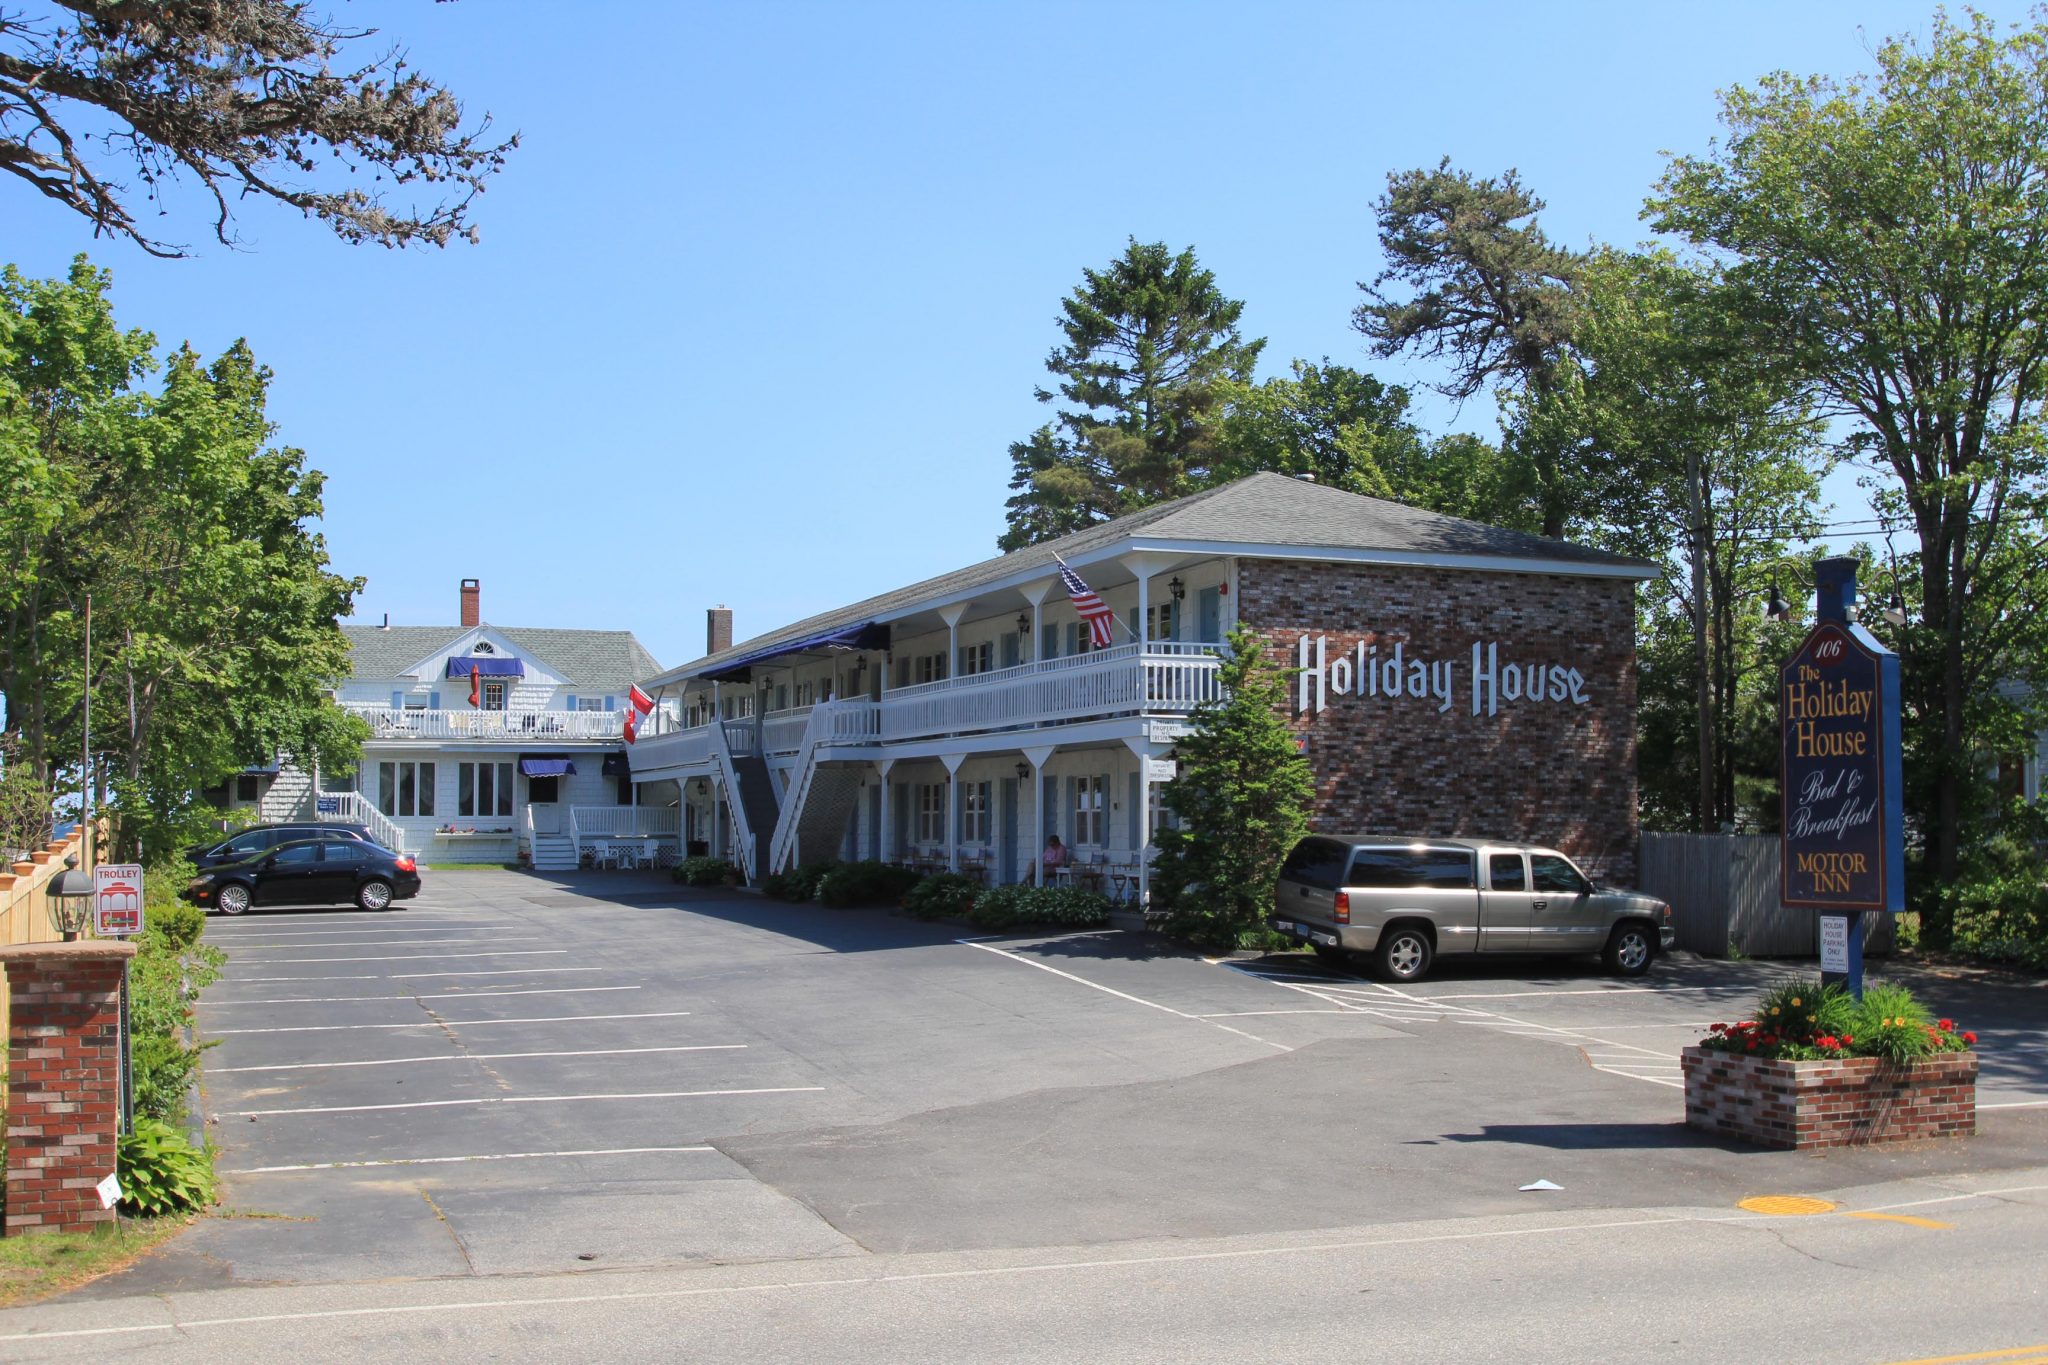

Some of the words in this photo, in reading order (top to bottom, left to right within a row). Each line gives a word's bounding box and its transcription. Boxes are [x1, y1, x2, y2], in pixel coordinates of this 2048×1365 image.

[1816, 640, 1842, 658] 106
[1299, 634, 1452, 713] Holiday
[1472, 640, 1590, 718] House
[1798, 665, 1820, 682] The
[1787, 678, 1873, 723] Holiday
[1796, 720, 1866, 757] House
[1799, 769, 1846, 805] Bed
[1847, 769, 1864, 794] &
[1787, 797, 1877, 840] Breakfast
[1797, 853, 1867, 873] MOTOR
[98, 870, 138, 879] TROLLEY
[1814, 873, 1850, 892] INN
[1823, 921, 1845, 929] HOLIDAY
[1823, 939, 1845, 947] PARKING
[1827, 947, 1840, 955] ONLY
